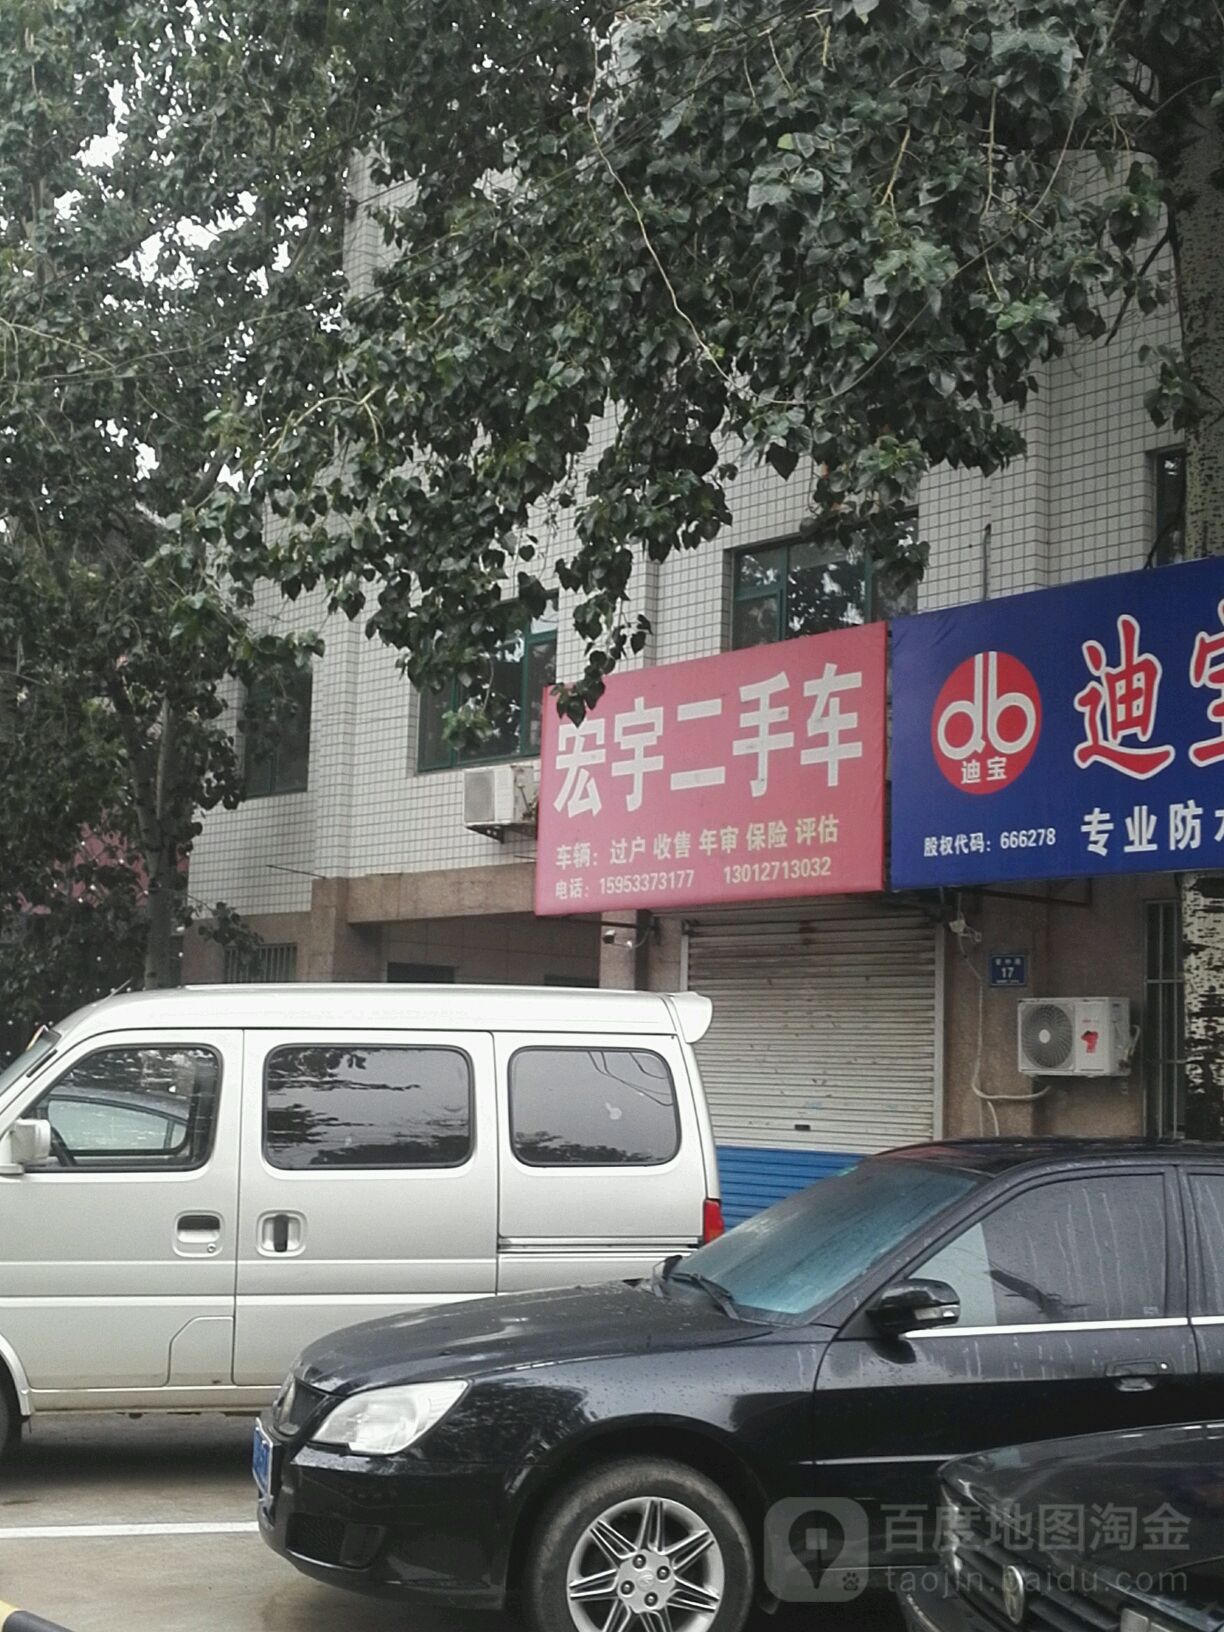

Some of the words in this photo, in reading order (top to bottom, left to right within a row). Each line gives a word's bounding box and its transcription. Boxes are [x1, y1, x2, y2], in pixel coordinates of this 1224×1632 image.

[553, 662, 863, 818] 宏宇二手车
[961, 756, 1008, 784] 迪宝
[723, 856, 832, 884] 13012713032
